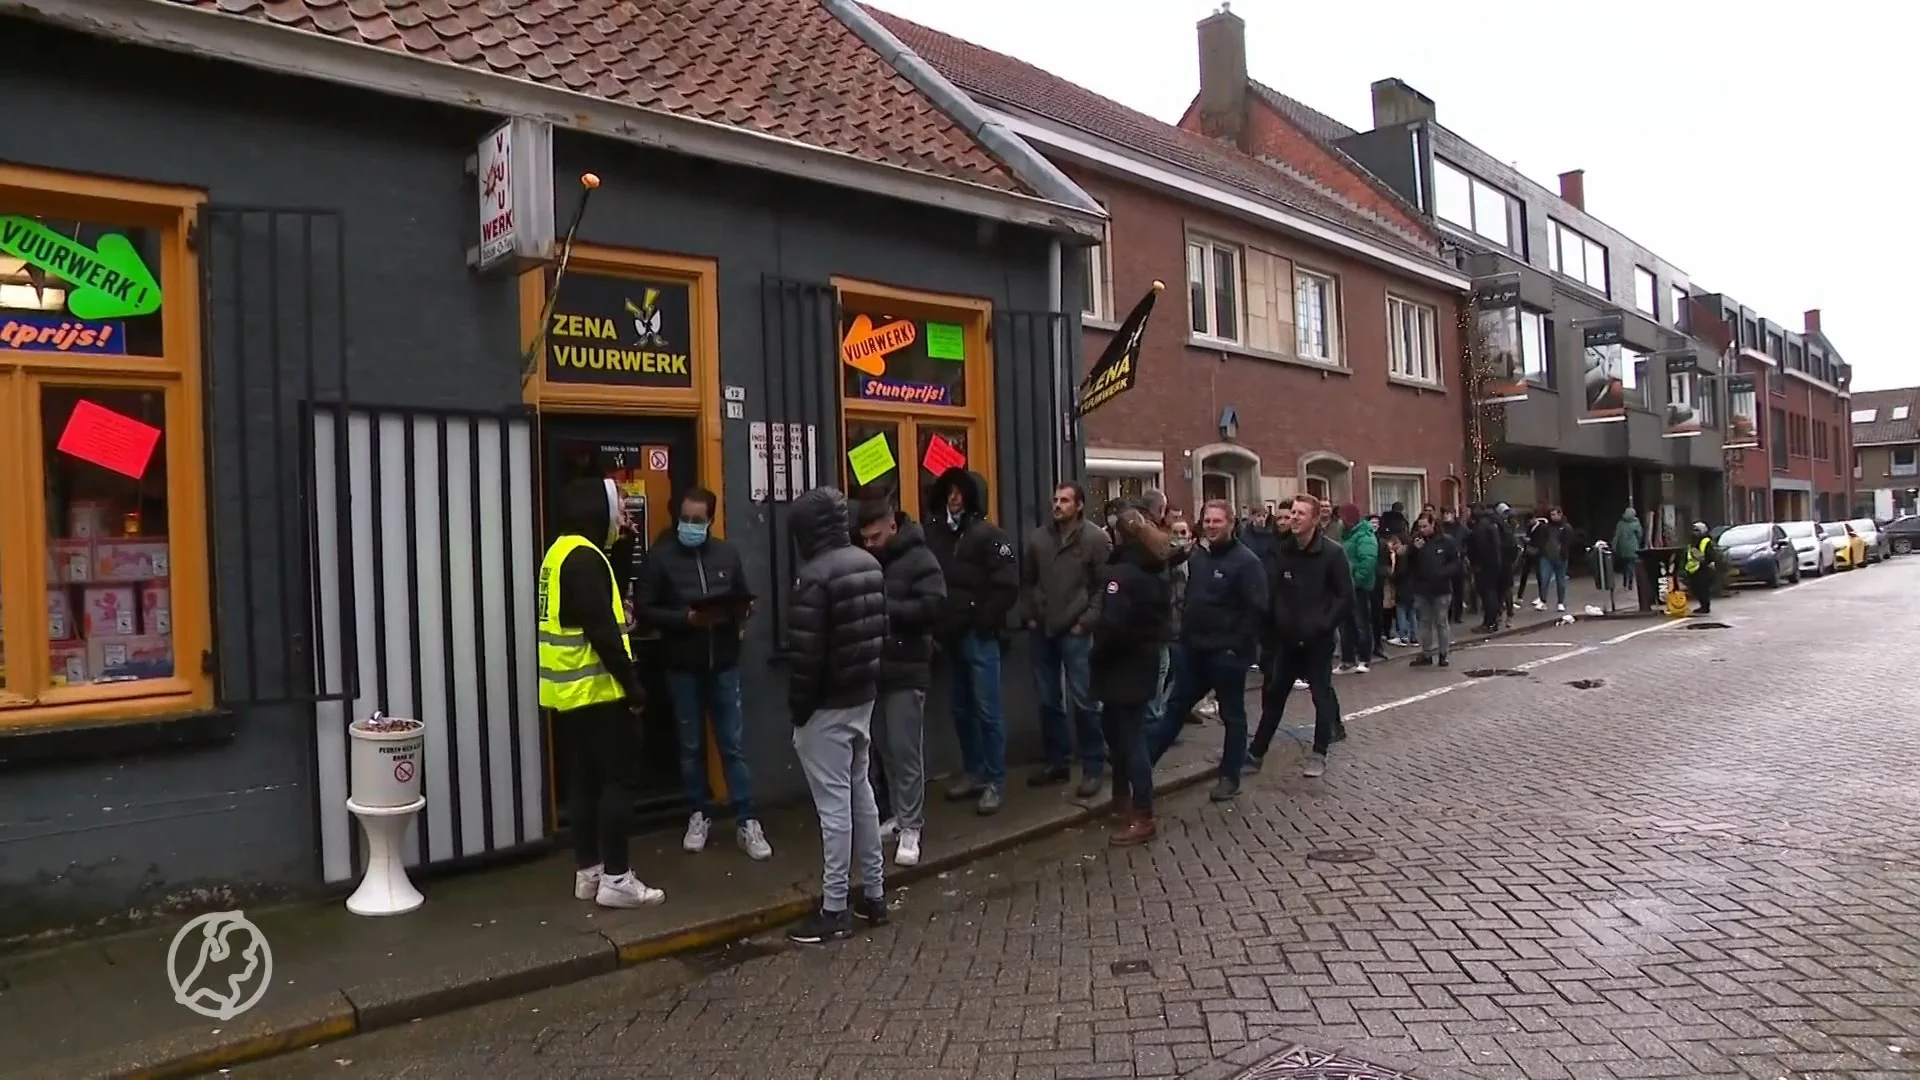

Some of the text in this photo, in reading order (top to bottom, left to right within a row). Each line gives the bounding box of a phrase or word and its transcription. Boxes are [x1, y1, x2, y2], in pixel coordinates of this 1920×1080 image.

[482, 209, 513, 242] WERK
[552, 313, 618, 340] ZENA
[844, 323, 914, 361] VUURWERK!
[552, 344, 688, 375] VUURWERK
[731, 389, 740, 398] 12
[864, 379, 945, 402] Stuntprijs!
